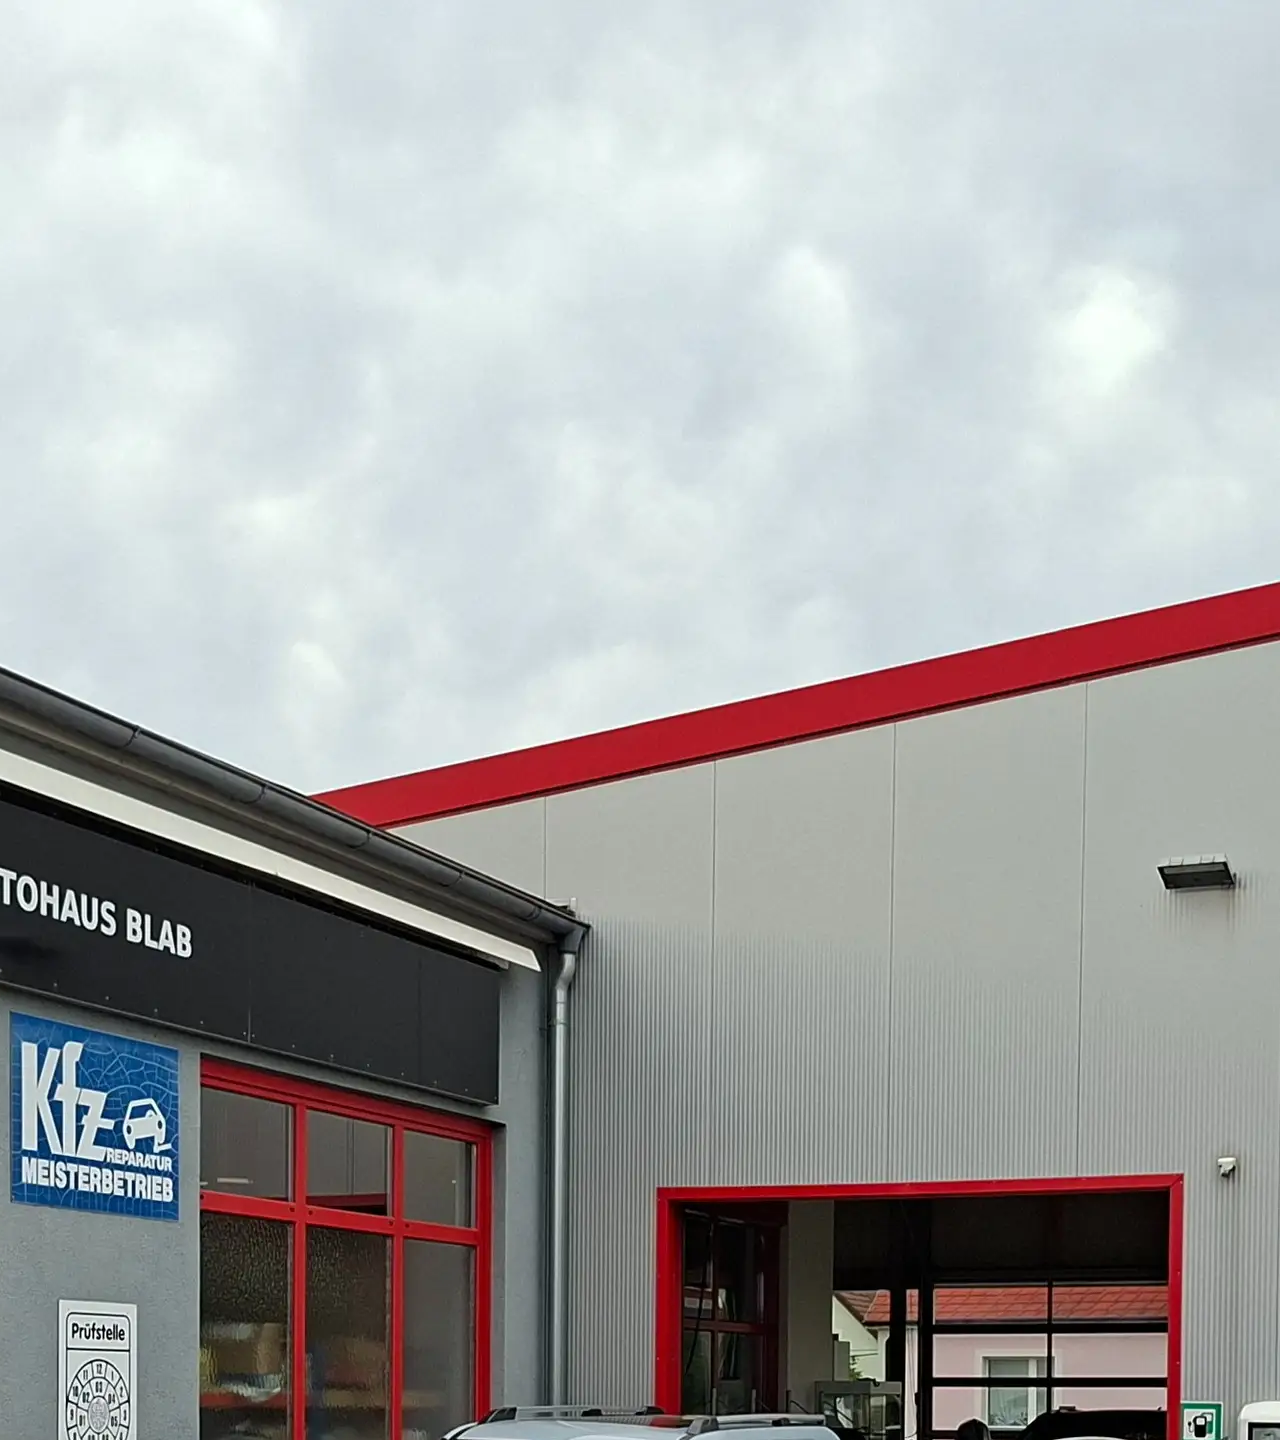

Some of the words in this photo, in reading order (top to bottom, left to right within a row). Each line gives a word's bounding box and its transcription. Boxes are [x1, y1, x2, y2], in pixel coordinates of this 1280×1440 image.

[126, 907, 192, 958] BLAB
[21, 1041, 115, 1161] Kfz
[106, 1147, 173, 1172] REPARATUR
[21, 1156, 174, 1202] MEISTERBETRIEB
[71, 1322, 125, 1341] Prüfstelle
[96, 1363, 102, 1374] 12
